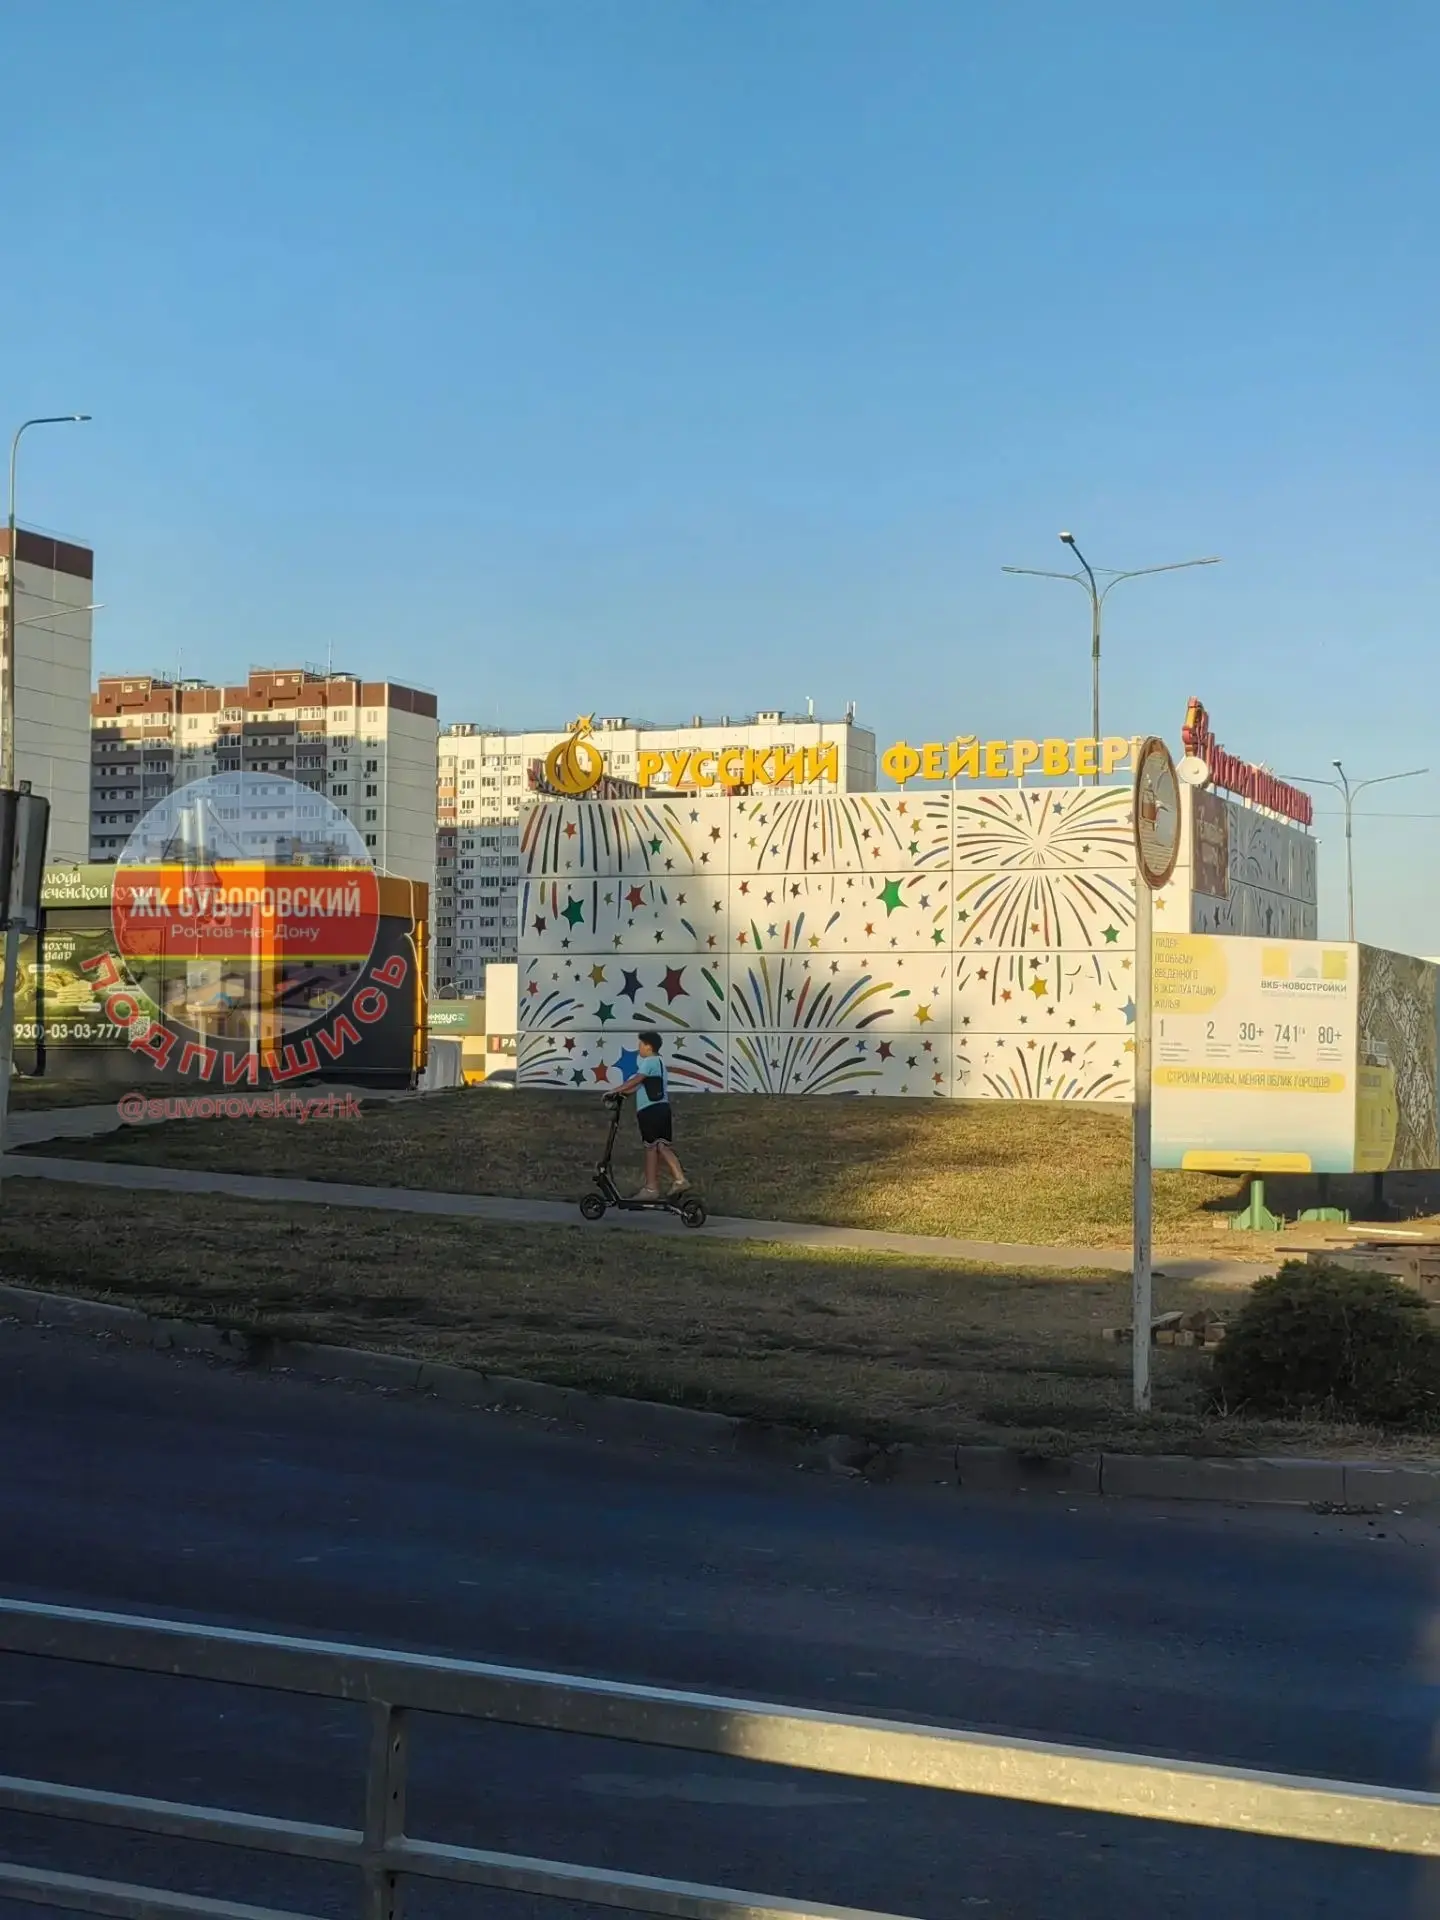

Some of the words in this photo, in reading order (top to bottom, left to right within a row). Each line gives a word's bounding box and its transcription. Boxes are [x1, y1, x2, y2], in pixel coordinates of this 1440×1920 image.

[638, 741, 839, 788] РУССКИЙ
[1159, 1018, 1165, 1037] 1
[1206, 1020, 1215, 1039] 2
[1238, 1022, 1265, 1041] 30+
[1317, 1026, 1343, 1044] 80+
[1167, 1071, 1200, 1084] СТРОИМ
